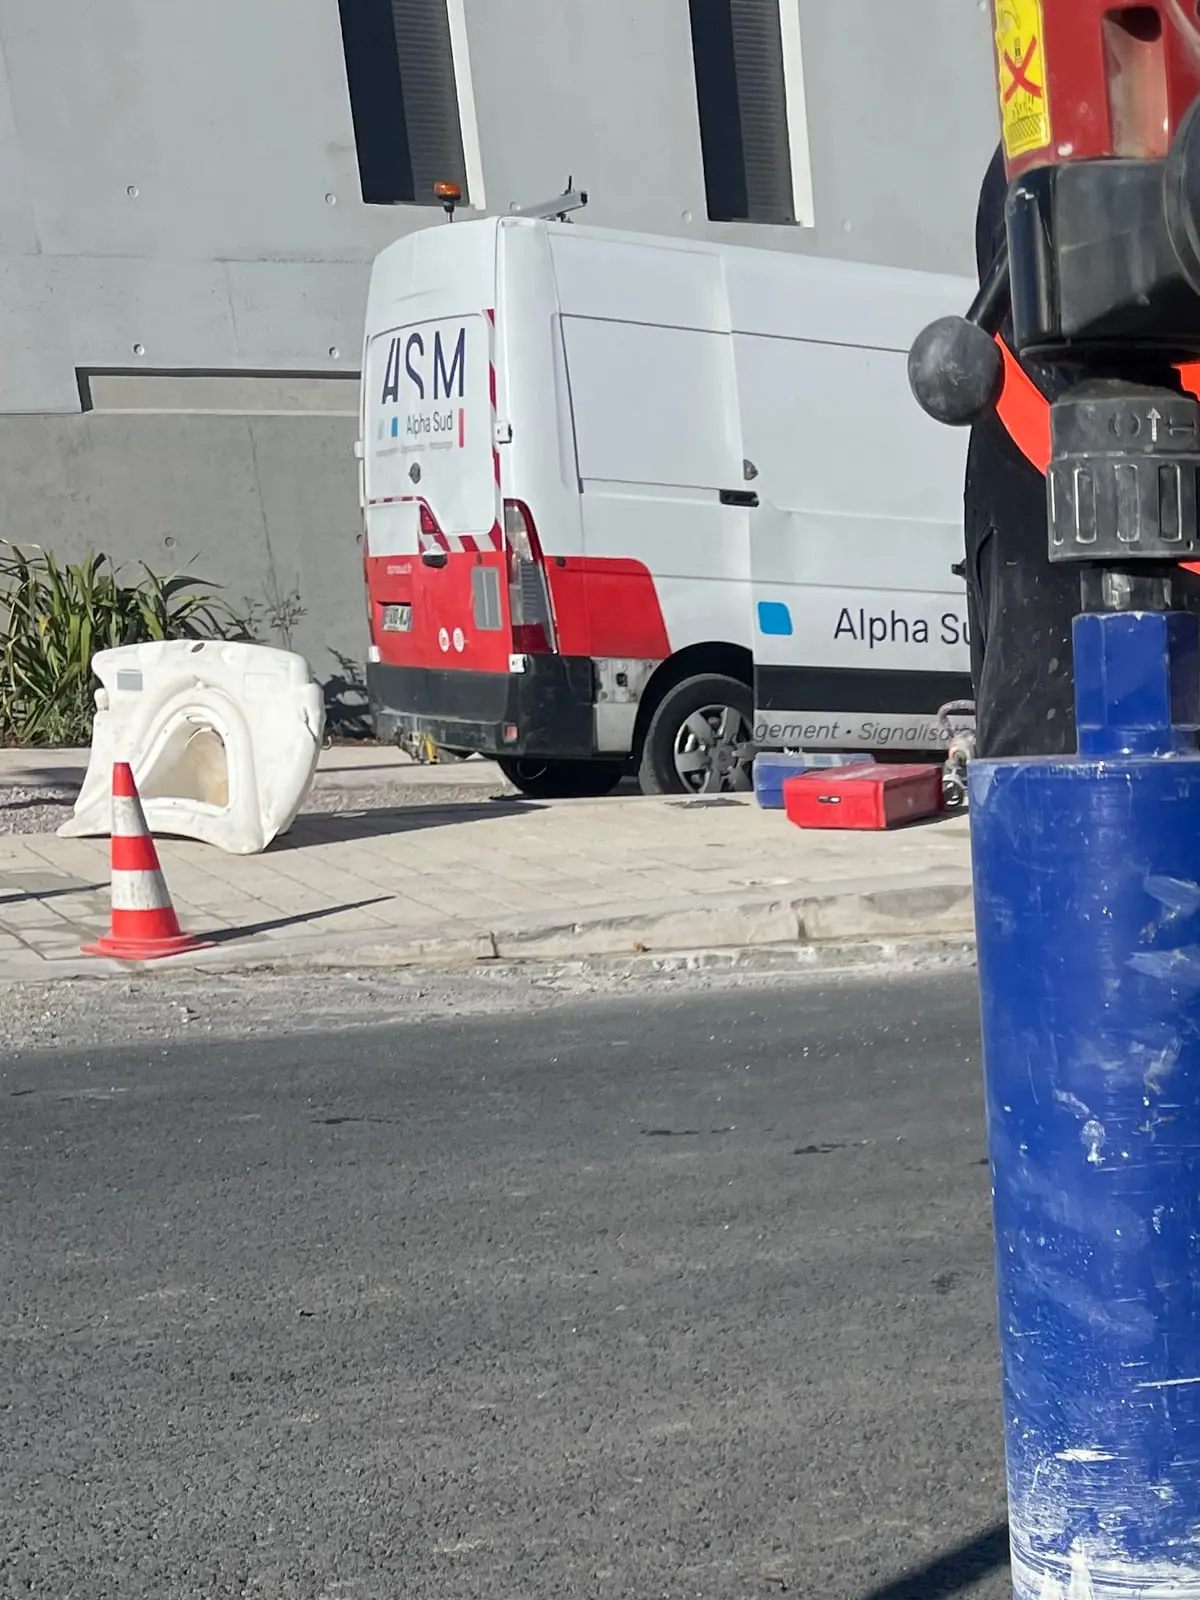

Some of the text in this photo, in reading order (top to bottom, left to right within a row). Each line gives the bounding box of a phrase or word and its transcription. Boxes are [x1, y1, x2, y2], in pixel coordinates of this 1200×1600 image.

[382, 328, 465, 404] ASM
[406, 410, 453, 439] Alpha Sud
[834, 608, 928, 649] Alpha
[755, 722, 840, 743] gement
